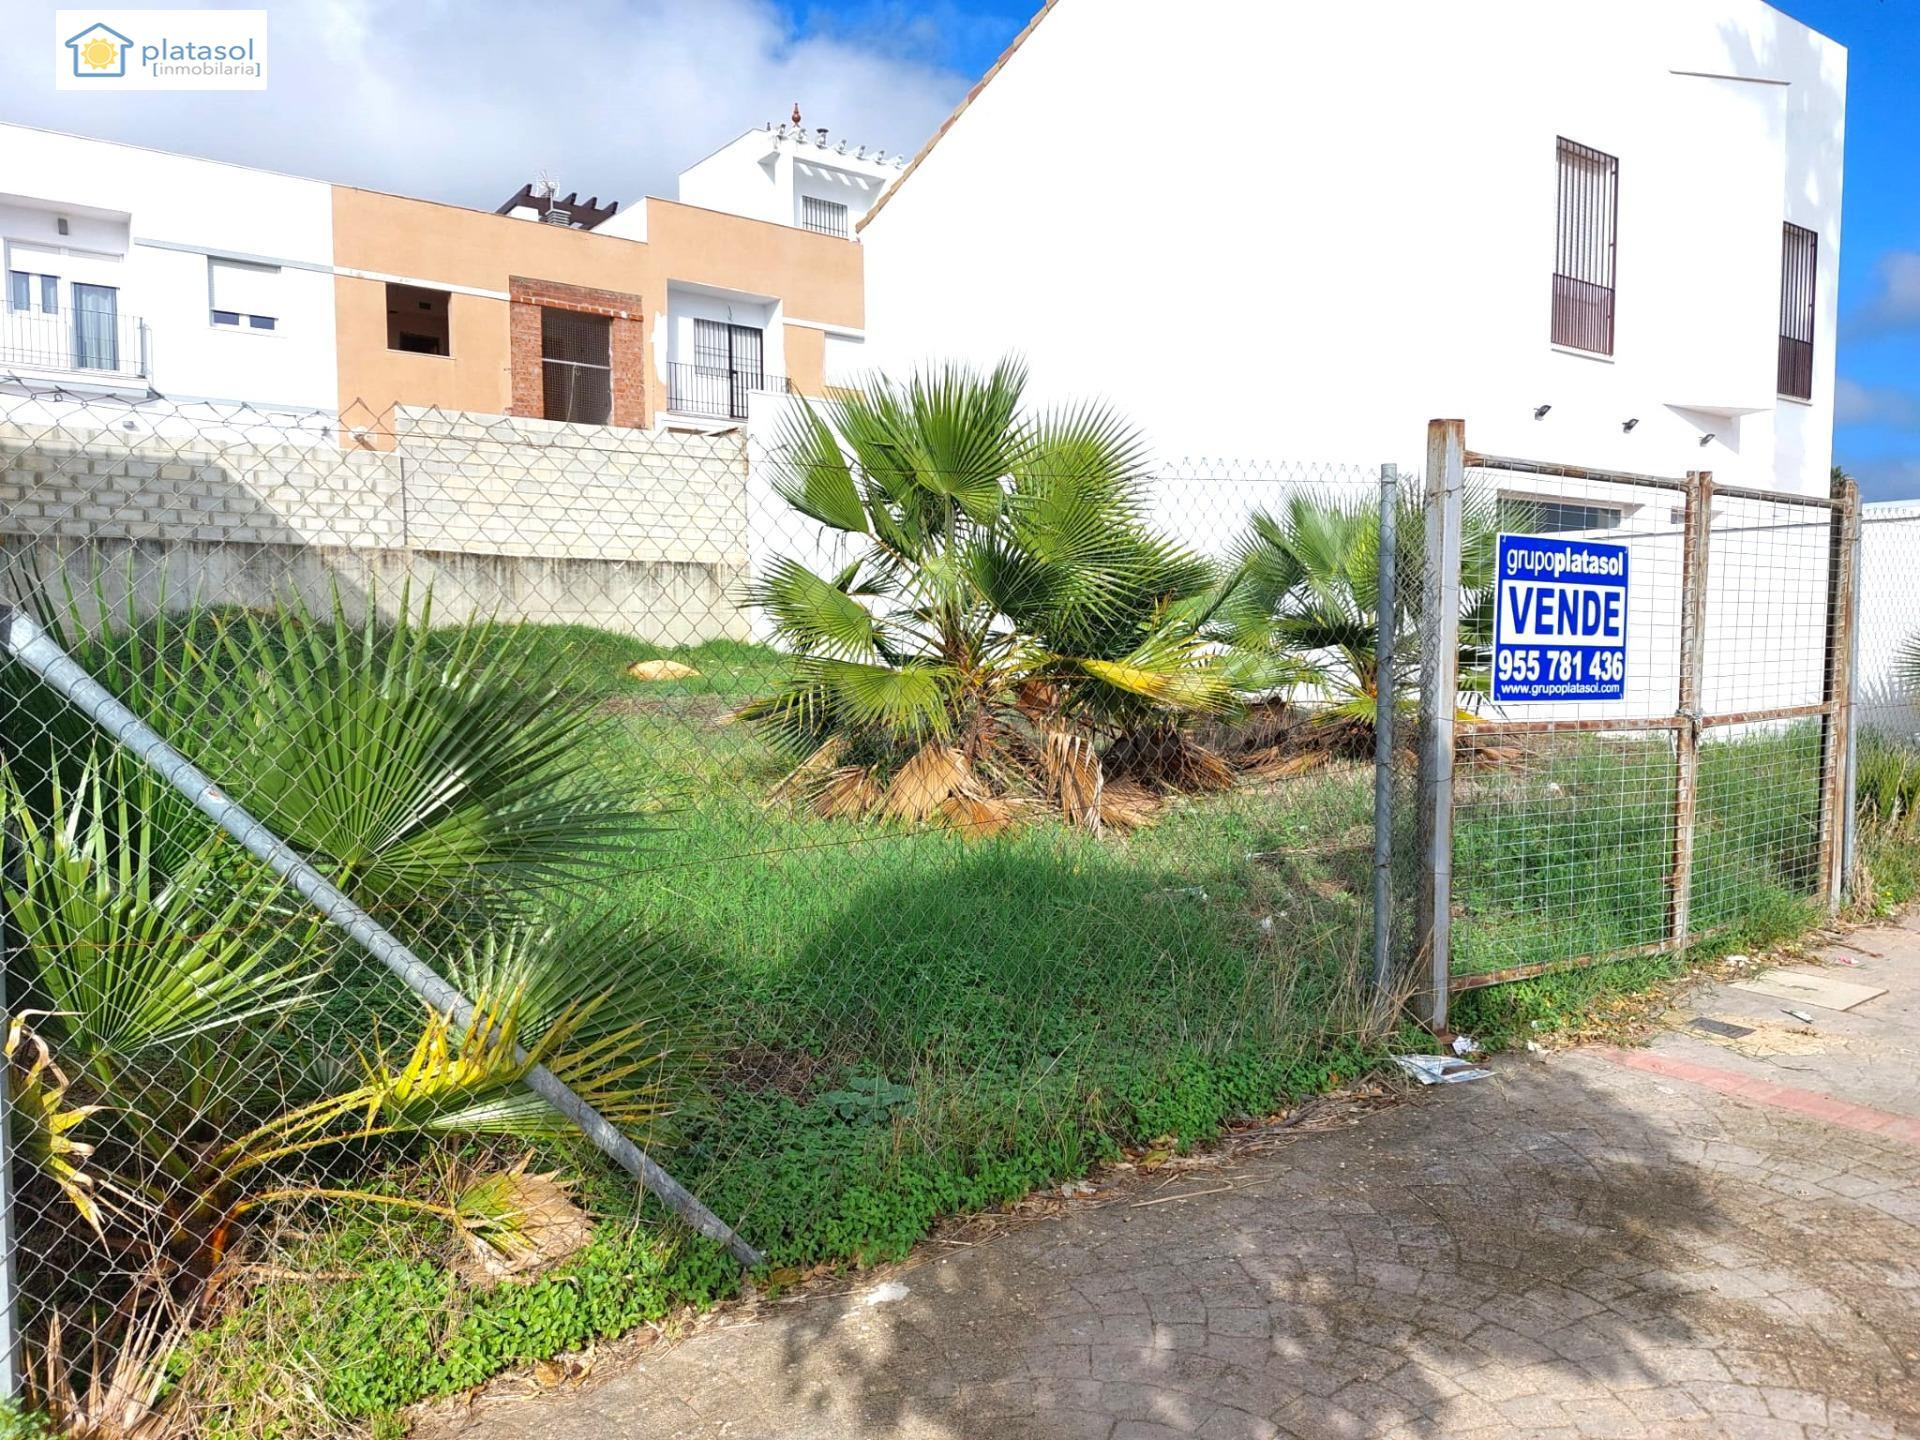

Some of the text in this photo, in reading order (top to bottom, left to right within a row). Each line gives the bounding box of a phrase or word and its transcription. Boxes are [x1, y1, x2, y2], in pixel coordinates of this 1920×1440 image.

[1506, 547, 1623, 578] grupoplatasol
[1508, 586, 1620, 637] VENDE
[1499, 649, 1624, 681] 955 781 436
[1501, 682, 1620, 697] www.grupoplatasol.com
